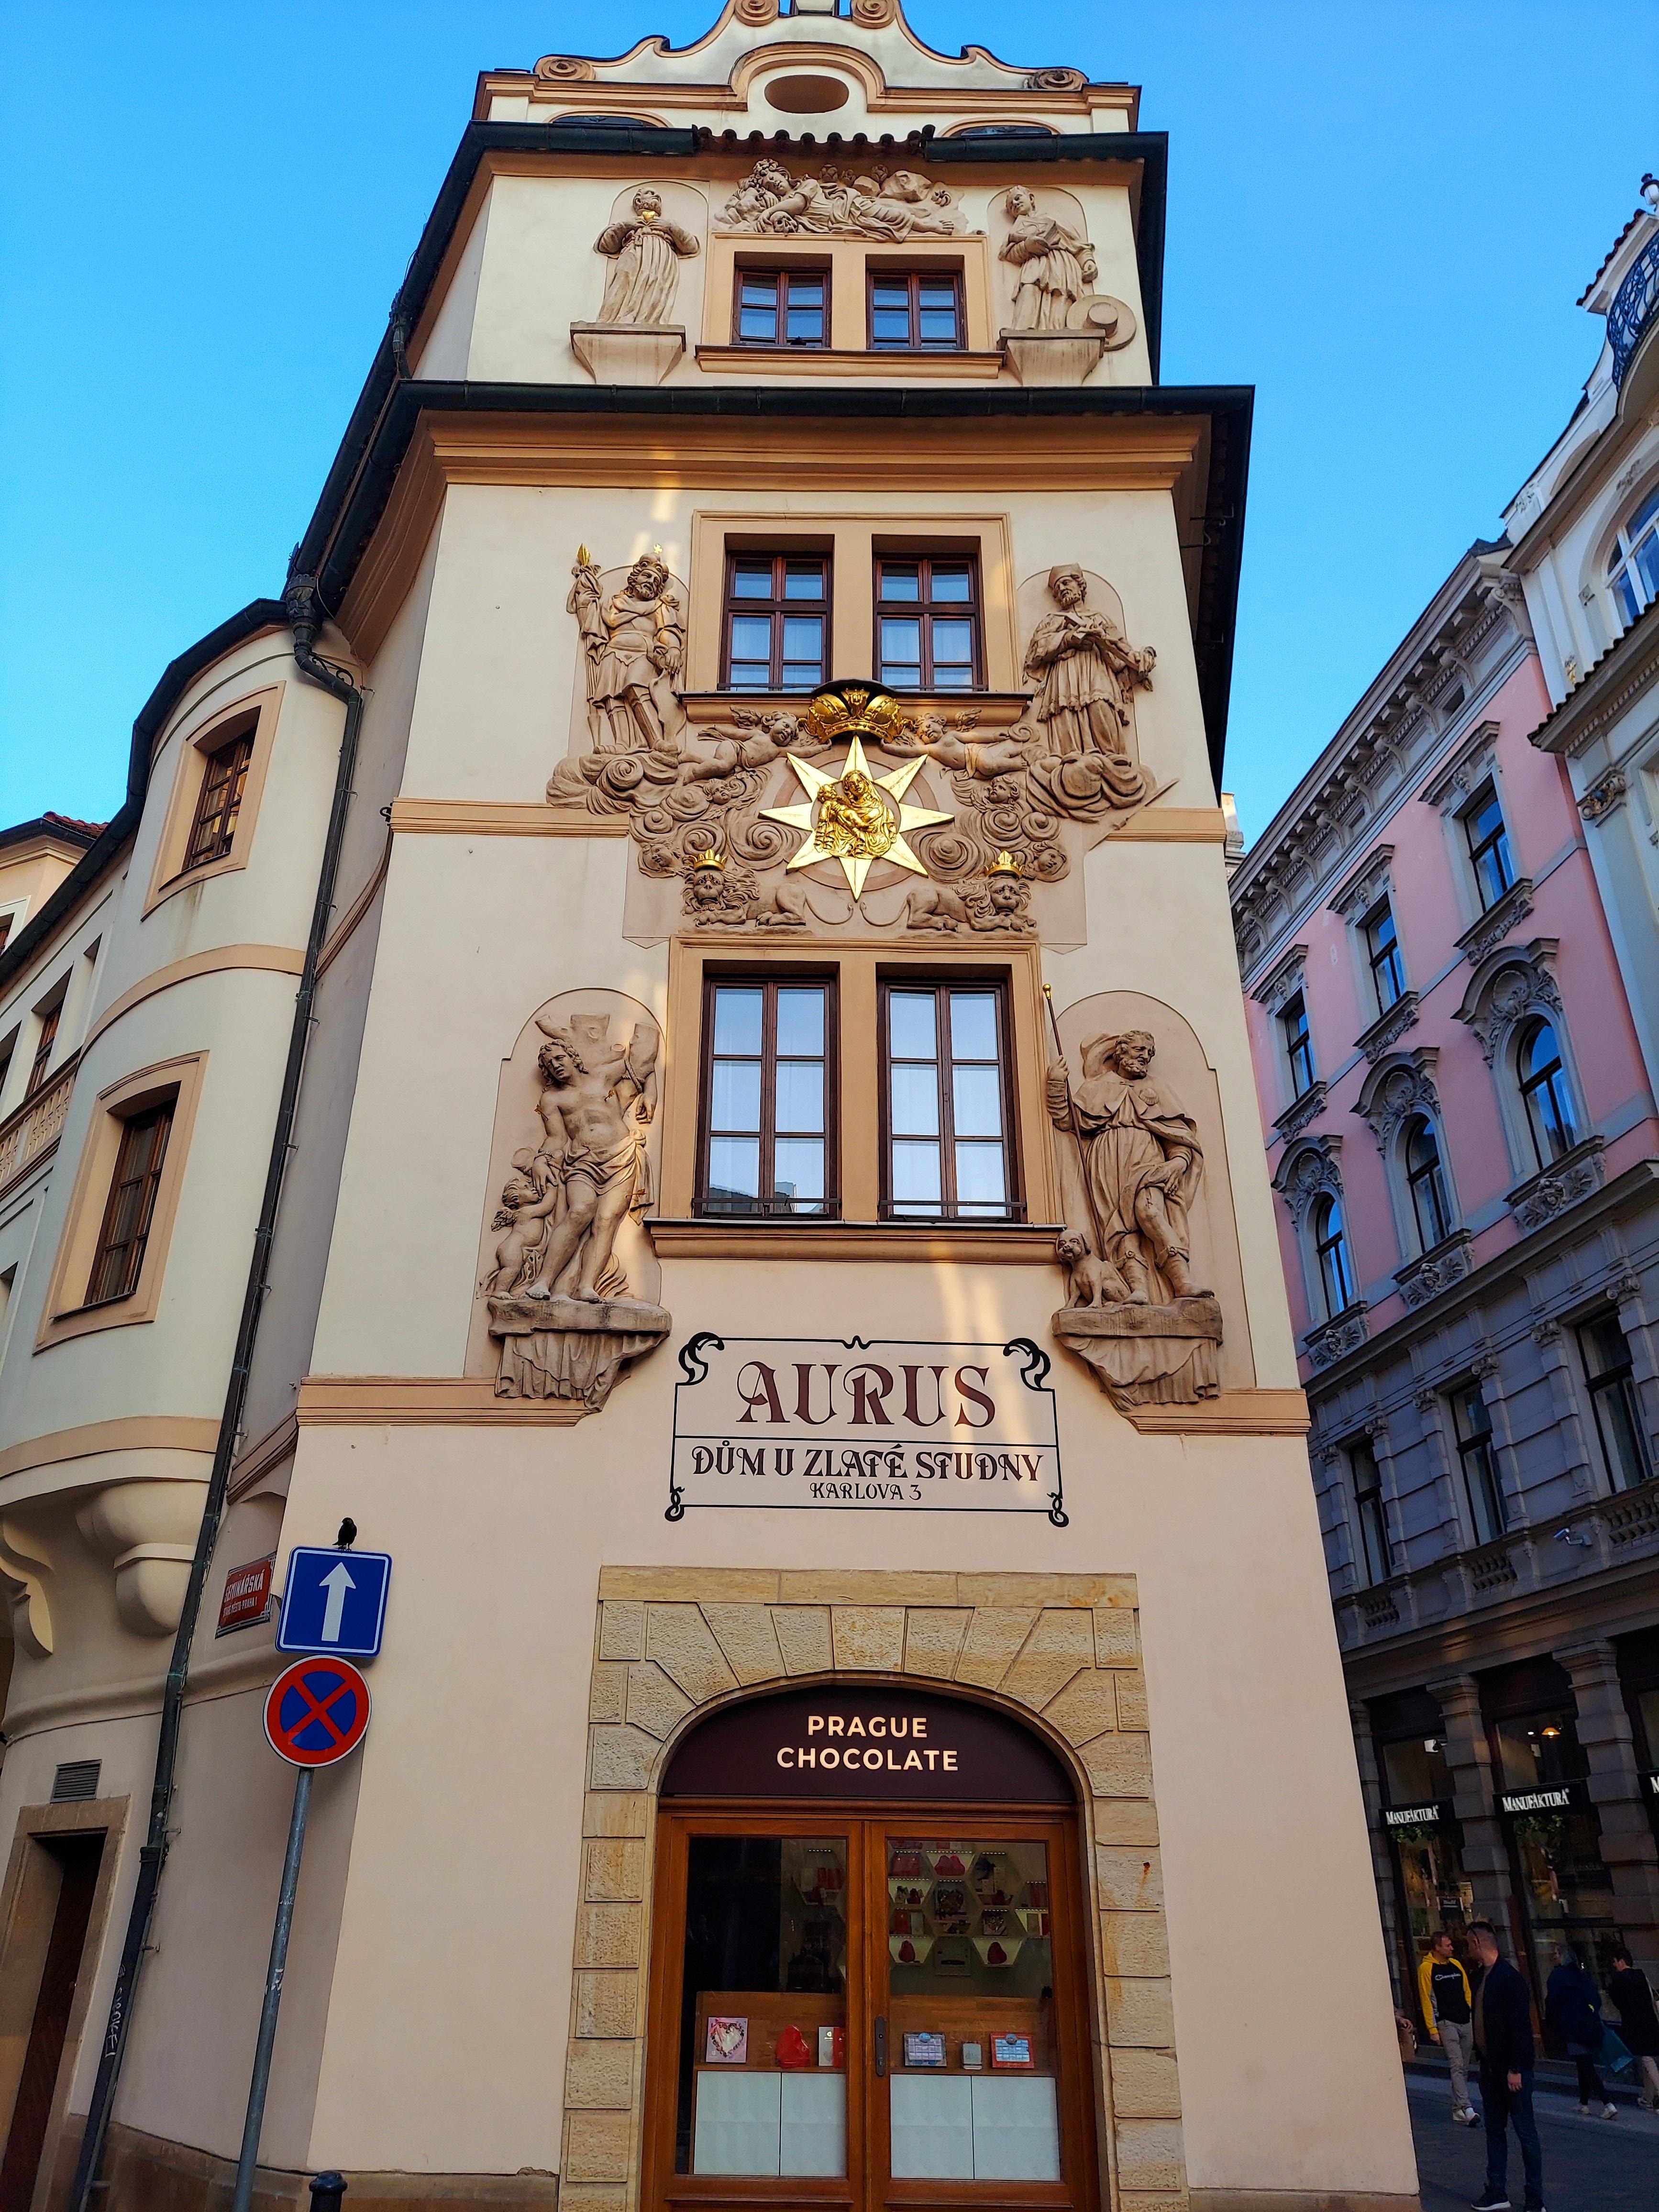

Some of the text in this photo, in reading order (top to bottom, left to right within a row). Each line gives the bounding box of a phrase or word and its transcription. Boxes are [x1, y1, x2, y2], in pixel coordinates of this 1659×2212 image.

[736, 1361, 996, 1428] AURUS
[691, 1440, 1044, 1482] DŮM U ZLATÉ STUDNY
[809, 1482, 922, 1501] KARLOVA 3
[224, 1569, 265, 1603] SEMINÁŘSKÁ
[808, 1715, 927, 1738] PRAGUE
[776, 1747, 958, 1771] CHOCOLATE
